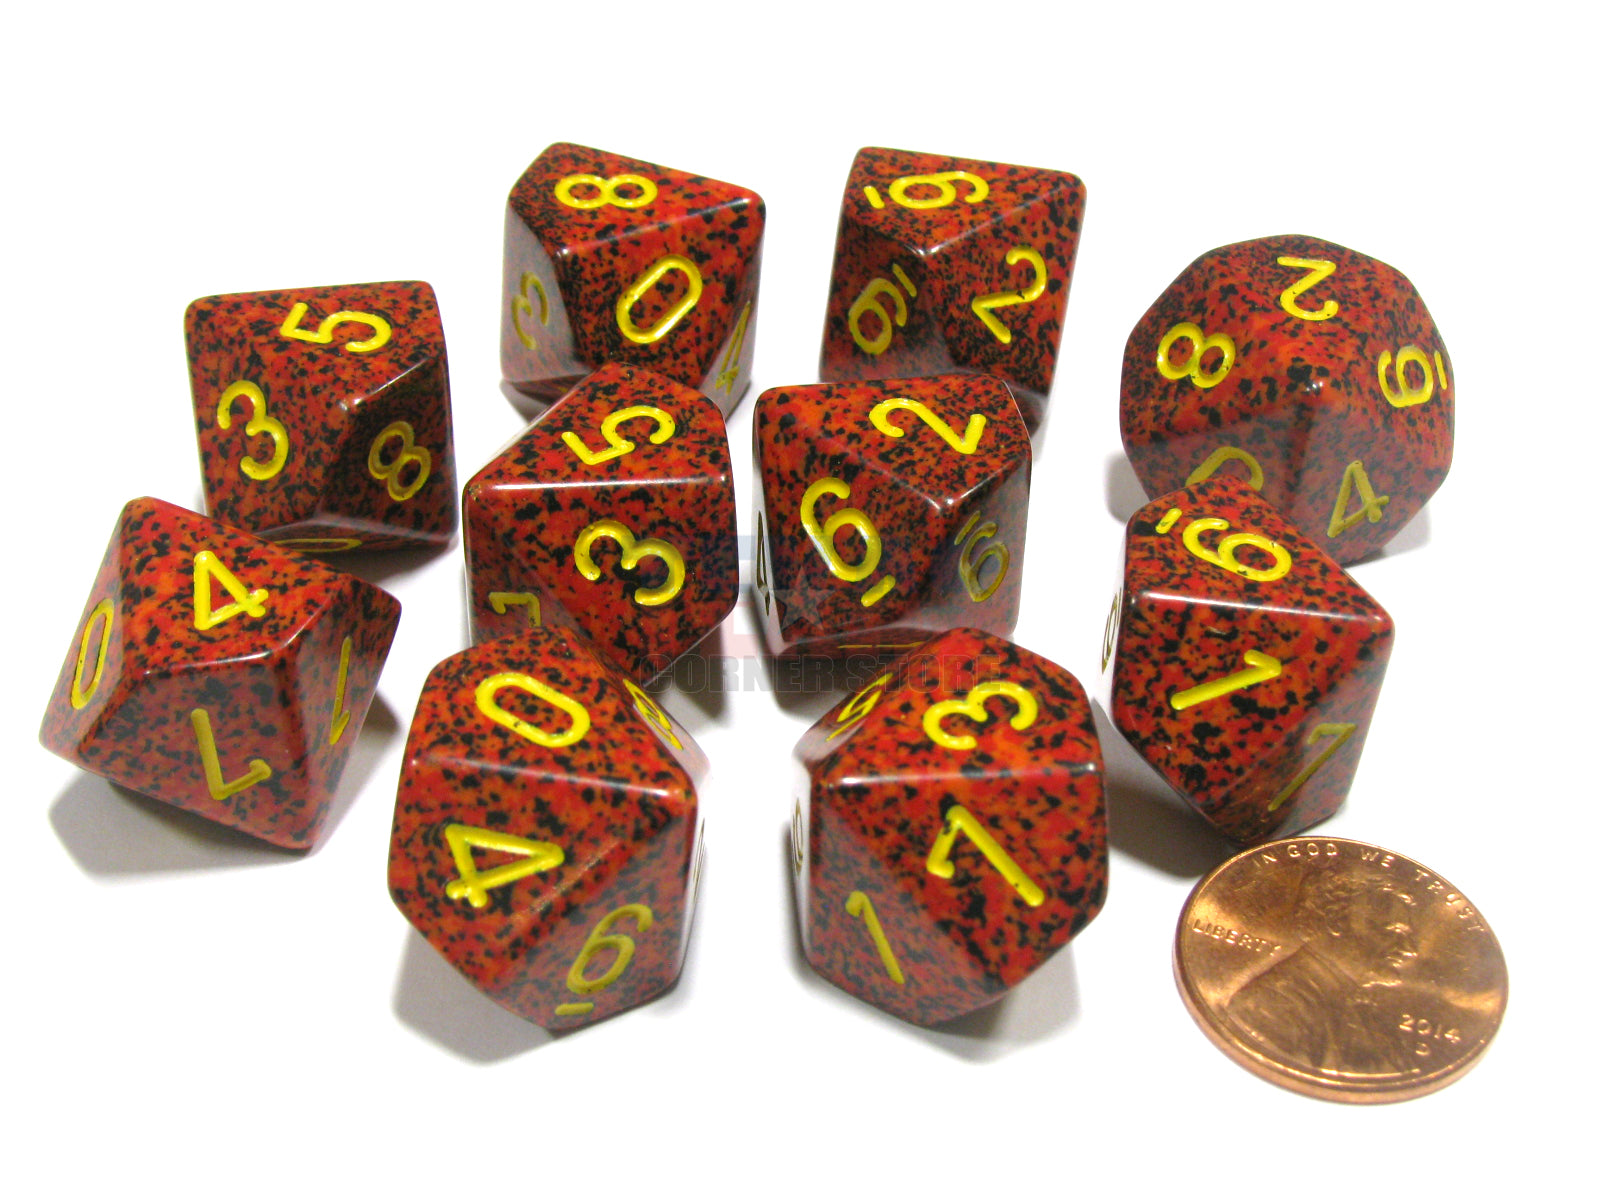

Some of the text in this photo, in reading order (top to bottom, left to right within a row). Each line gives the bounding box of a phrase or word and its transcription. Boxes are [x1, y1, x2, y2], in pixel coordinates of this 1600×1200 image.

[554, 174, 657, 209] 8
[511, 272, 548, 349] 3
[616, 254, 702, 343] 0
[972, 246, 1047, 343] 2
[1277, 256, 1339, 321] 2
[280, 302, 392, 353] 5
[1157, 322, 1236, 388] 8
[216, 380, 288, 480] 3
[367, 420, 431, 501] 8
[562, 405, 675, 465] 5
[869, 398, 986, 454] 2
[1327, 460, 1389, 538] 4
[193, 550, 269, 631] 4
[574, 520, 685, 606] 3
[71, 598, 115, 710] 0
[475, 672, 591, 748] 0
[923, 682, 1039, 750] 3
[444, 823, 565, 908] 4
[1253, 842, 1485, 932] IN GOD WE TRUST
[1192, 918, 1281, 956] LIBERTY
[1399, 1013, 1462, 1044] 2014
